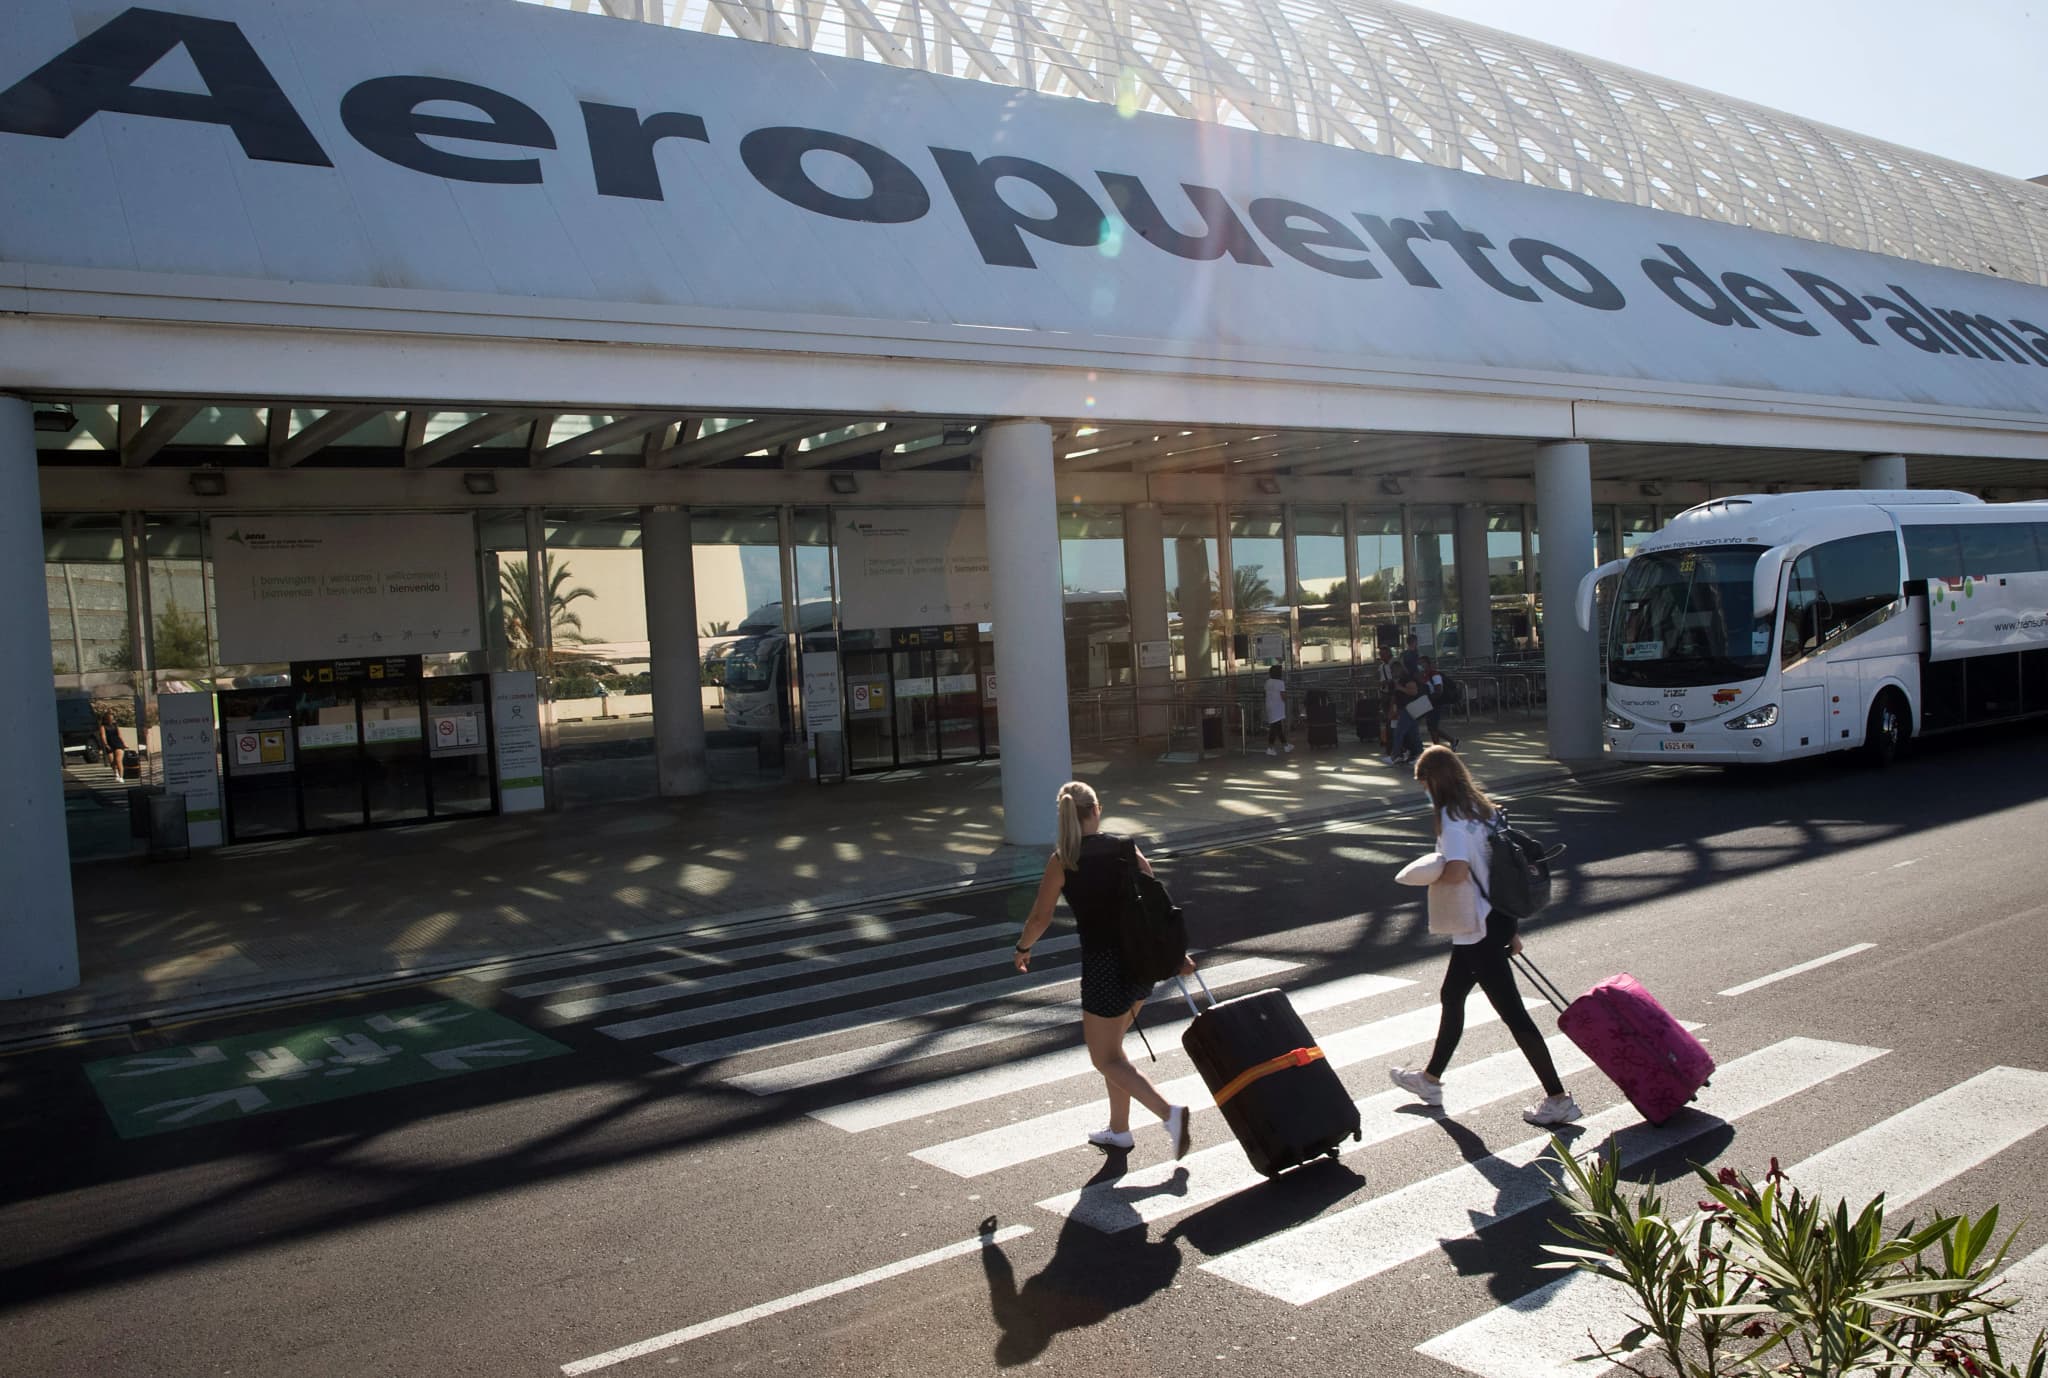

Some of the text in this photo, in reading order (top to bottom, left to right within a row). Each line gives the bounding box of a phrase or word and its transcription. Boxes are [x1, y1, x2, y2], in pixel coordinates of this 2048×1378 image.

[0, 7, 1626, 310] Aeropuerto
[1641, 243, 1822, 336] de
[390, 582, 441, 593] bienvenido
